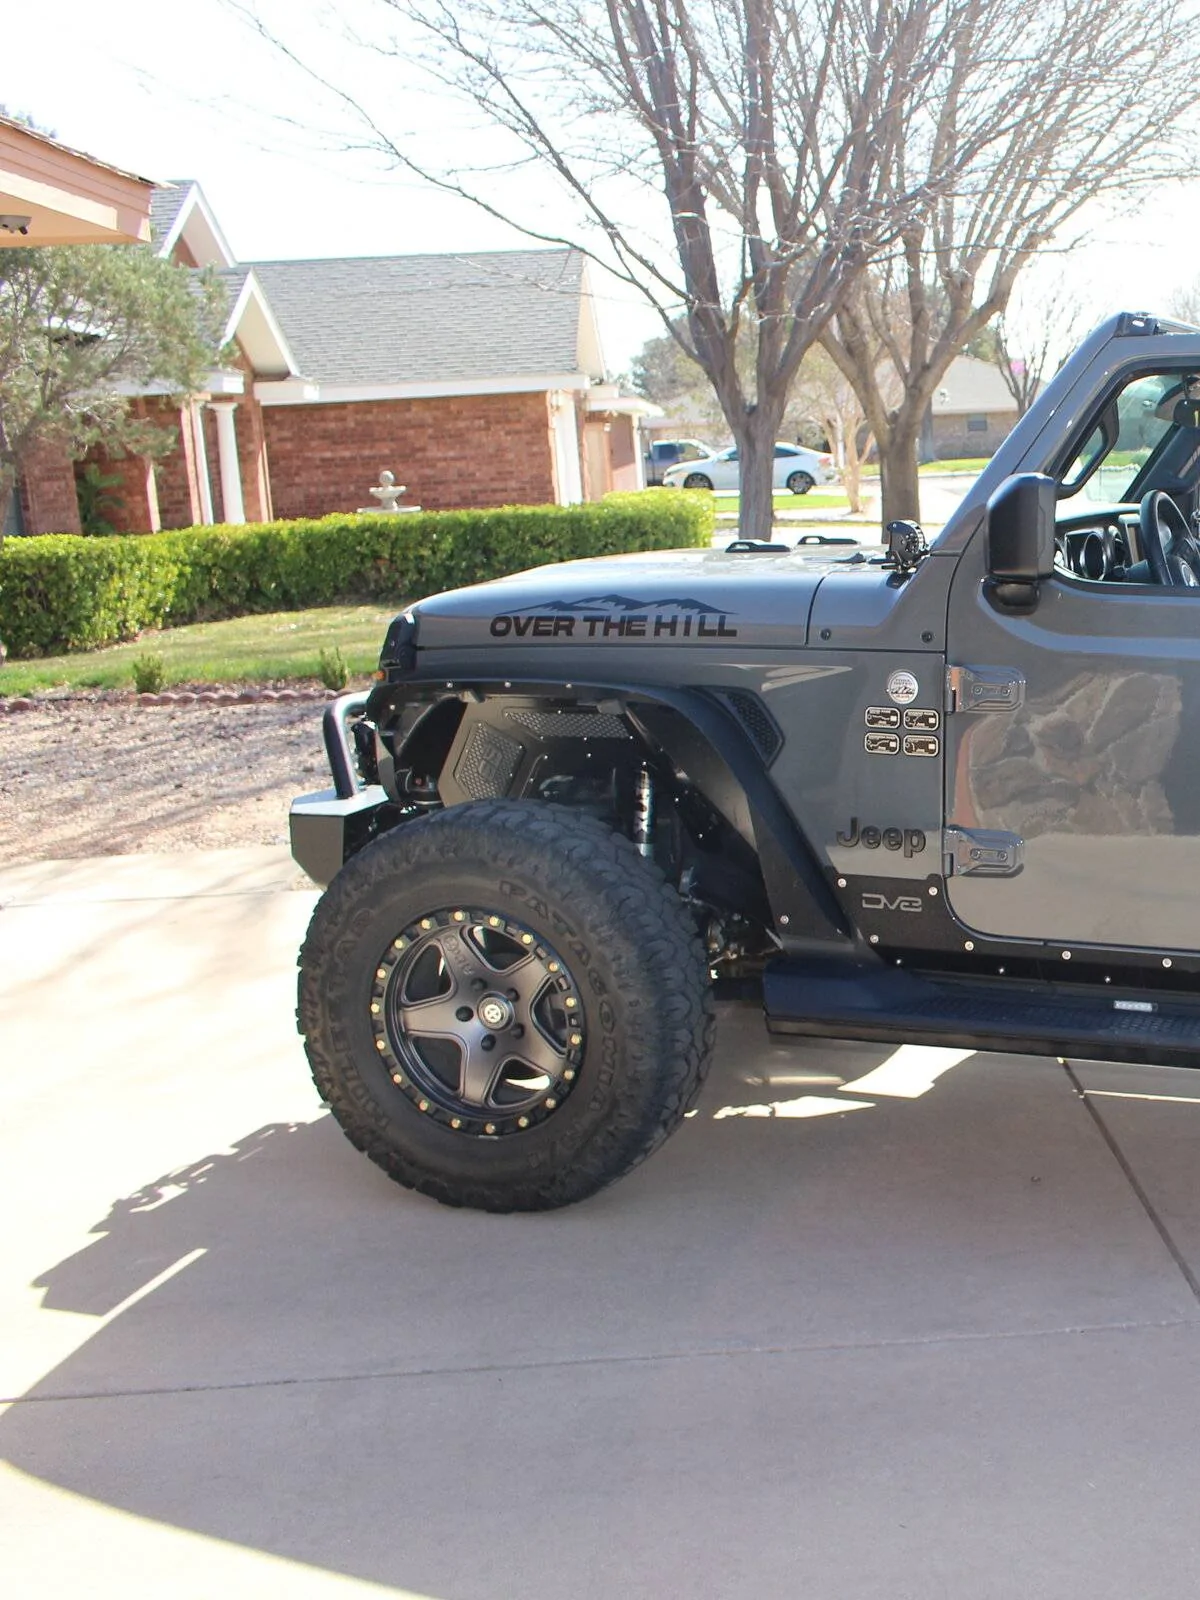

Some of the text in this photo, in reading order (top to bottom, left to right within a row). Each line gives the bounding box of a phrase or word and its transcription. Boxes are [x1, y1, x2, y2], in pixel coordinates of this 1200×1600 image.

[490, 615, 738, 637] OVER THE HILL
[836, 816, 926, 858] Jeep
